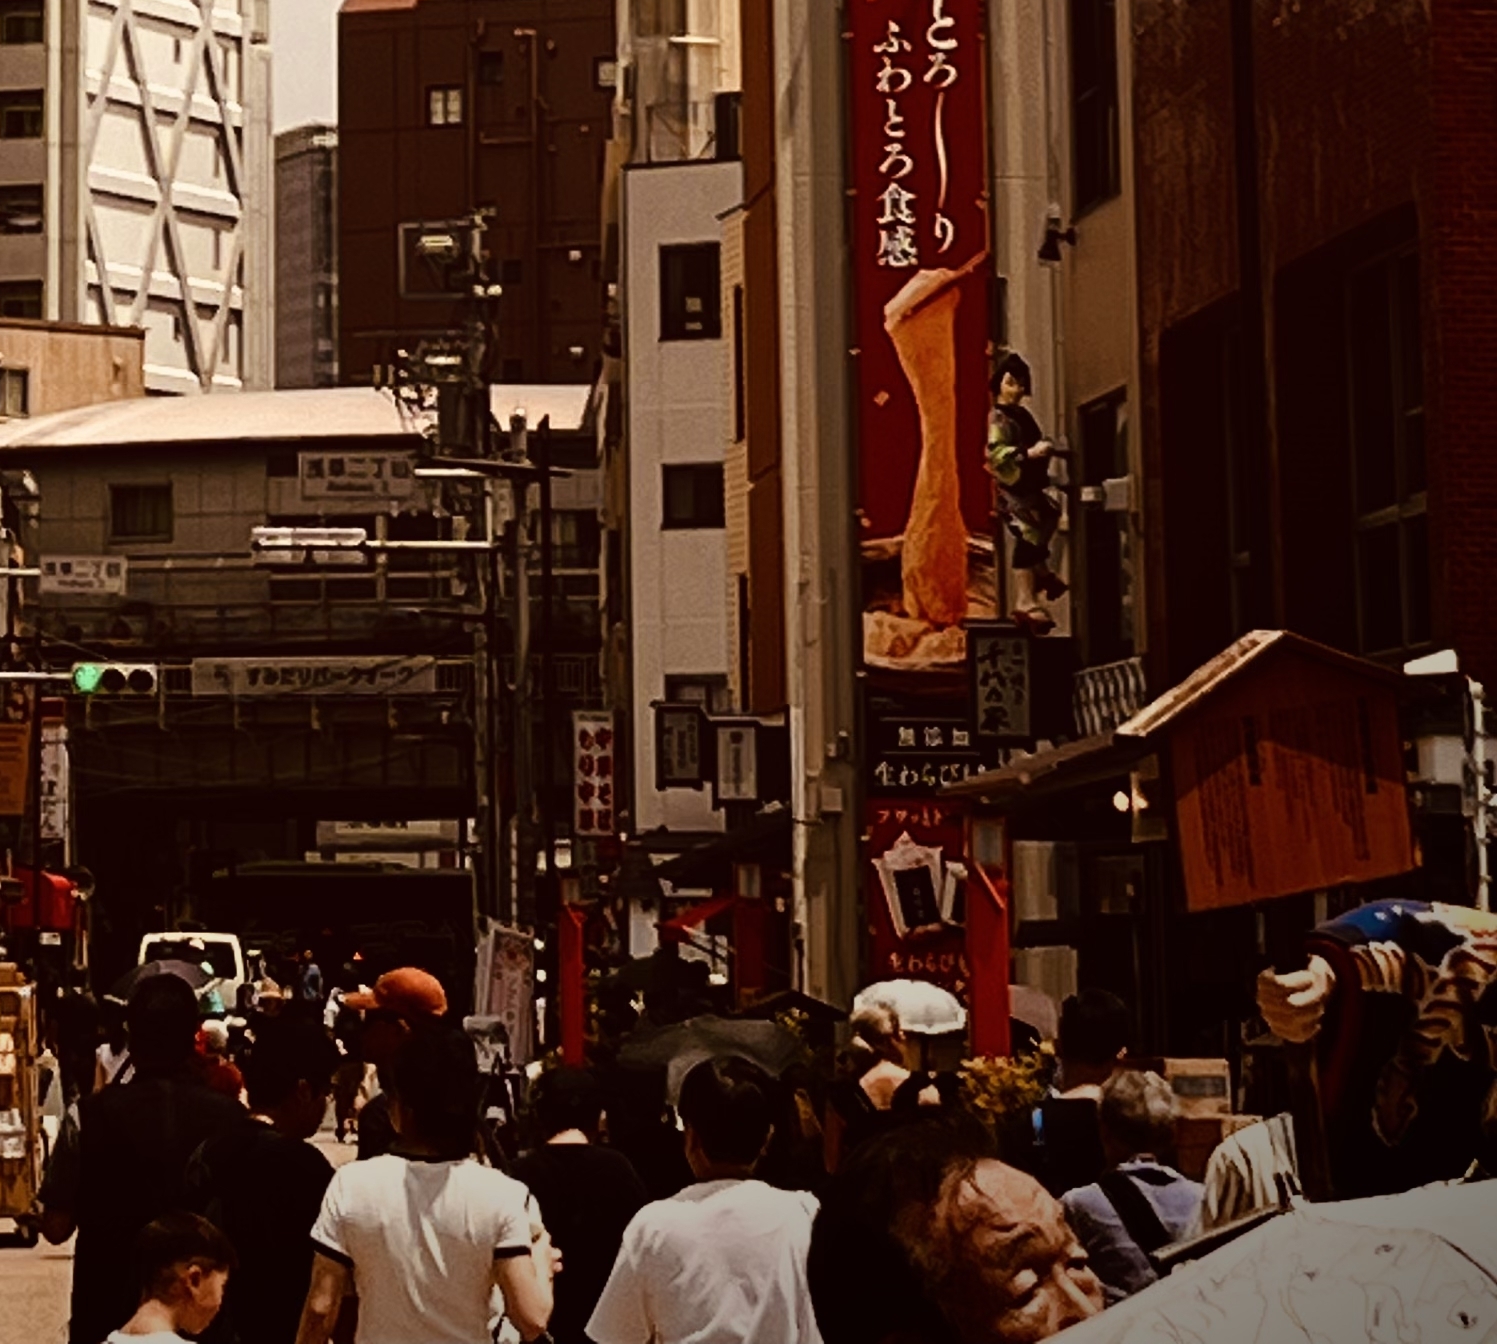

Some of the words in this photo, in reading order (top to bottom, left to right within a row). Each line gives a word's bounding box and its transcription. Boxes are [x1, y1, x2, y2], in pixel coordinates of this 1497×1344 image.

[872, 19, 919, 269] ふわとろ食感
